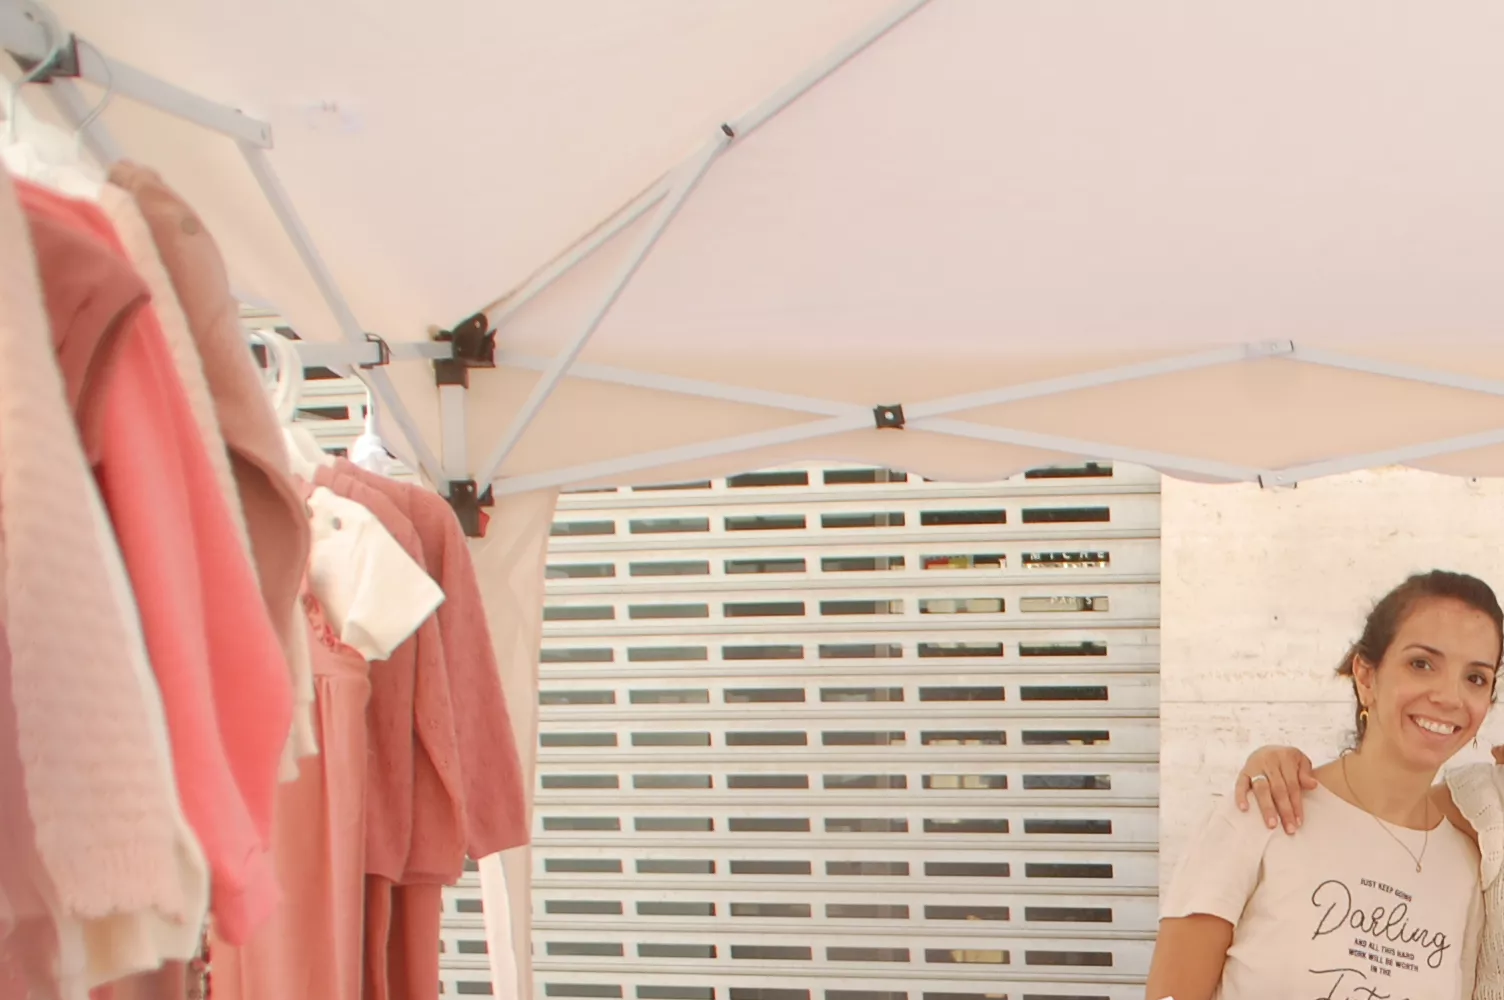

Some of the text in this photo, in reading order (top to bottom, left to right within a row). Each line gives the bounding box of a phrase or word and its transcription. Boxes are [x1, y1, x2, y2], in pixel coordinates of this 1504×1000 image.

[1360, 878, 1413, 902] JUST KEEP GOING
[1311, 879, 1451, 969] Darling
[1348, 948, 1419, 972] WORK WILL BE WORTH
[1354, 938, 1416, 961] AND ALL THIS HARD
[1370, 964, 1392, 977] IN THE
